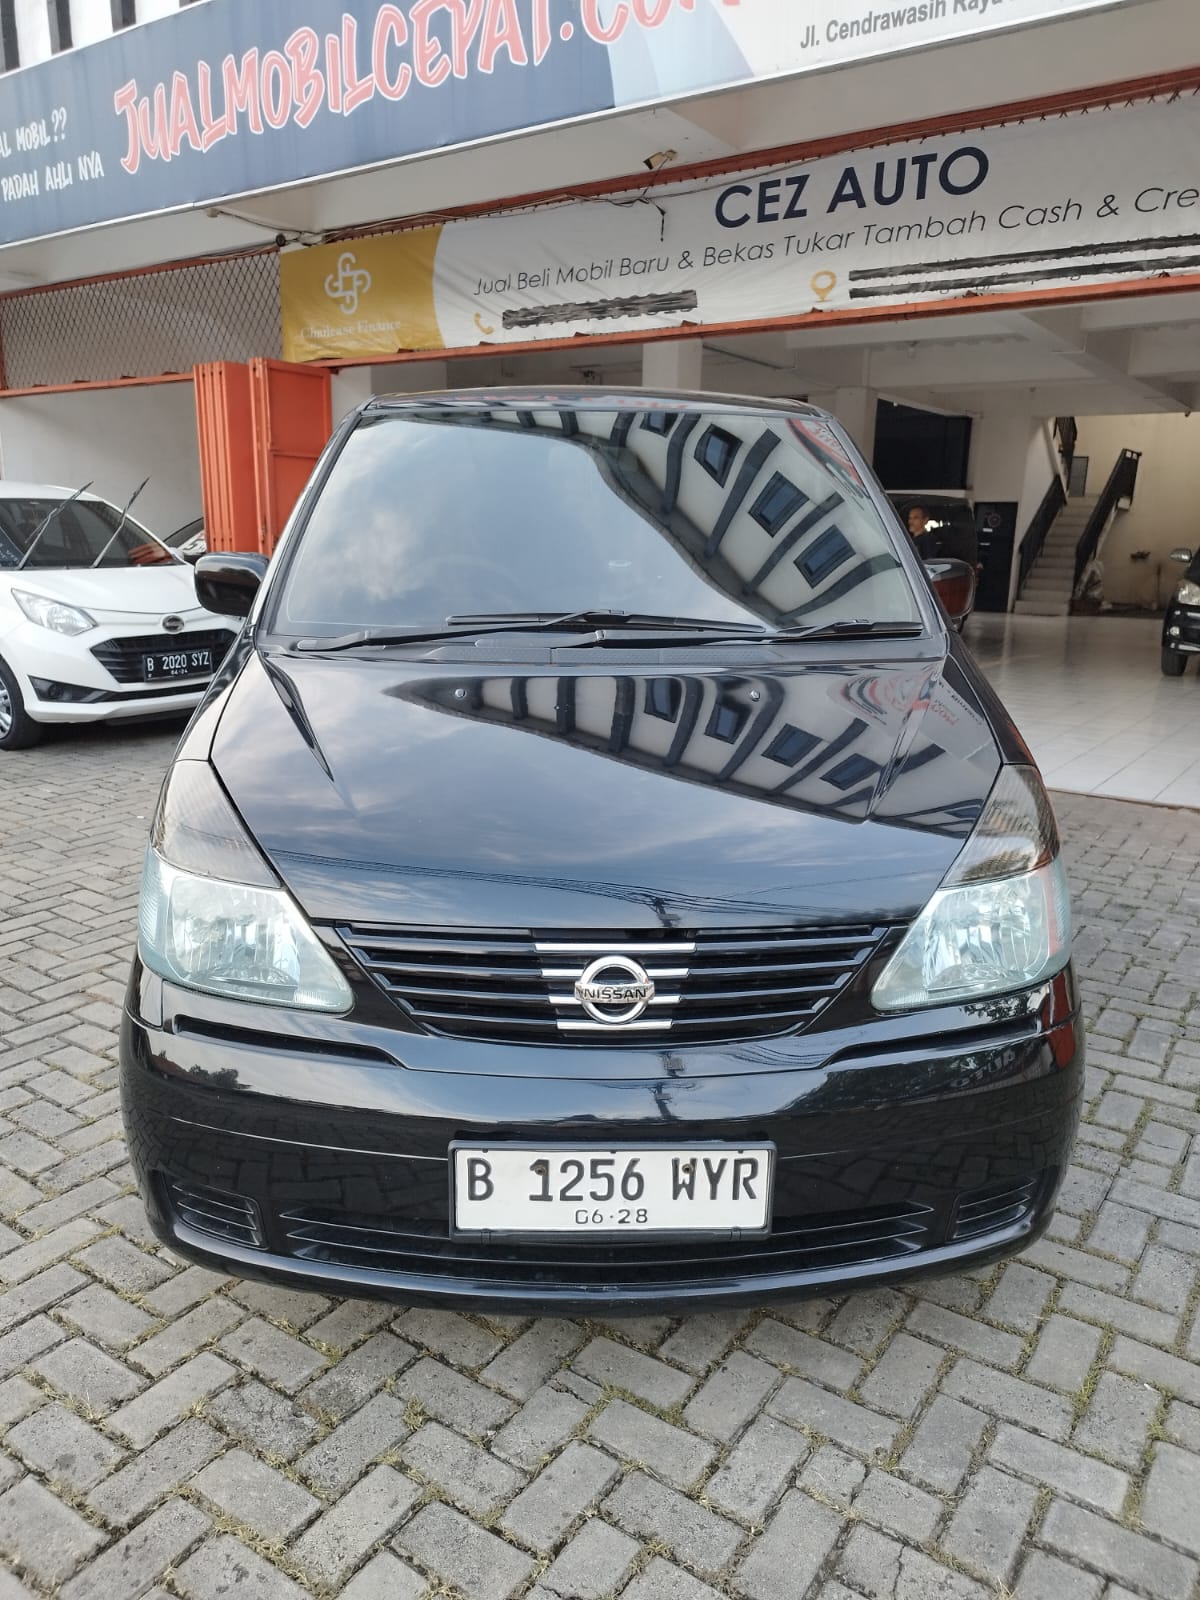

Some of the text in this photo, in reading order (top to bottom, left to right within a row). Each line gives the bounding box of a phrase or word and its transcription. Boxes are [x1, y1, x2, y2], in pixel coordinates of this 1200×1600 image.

[800, 27, 820, 49] Jl.
[825, 0, 946, 43] Cendrawasih
[114, 0, 743, 175] JUALMOBILCEPAT.
[1, 150, 105, 202] PADAH AHLI NYA
[715, 146, 990, 229] CEZ AUTO
[474, 273, 512, 296] Jual
[517, 268, 550, 290] Beli
[556, 259, 614, 286] Mobil
[619, 256, 670, 277] Baru
[677, 250, 694, 270] &
[703, 242, 775, 267] Bekas
[783, 231, 856, 256] Tukar
[863, 210, 986, 246] Tambah
[998, 197, 1083, 229] Cash
[1096, 194, 1120, 218] &
[147, 651, 209, 672] B 2020 SYZ
[584, 987, 646, 999] NISSAN
[467, 1157, 759, 1201] B 1256 WYR
